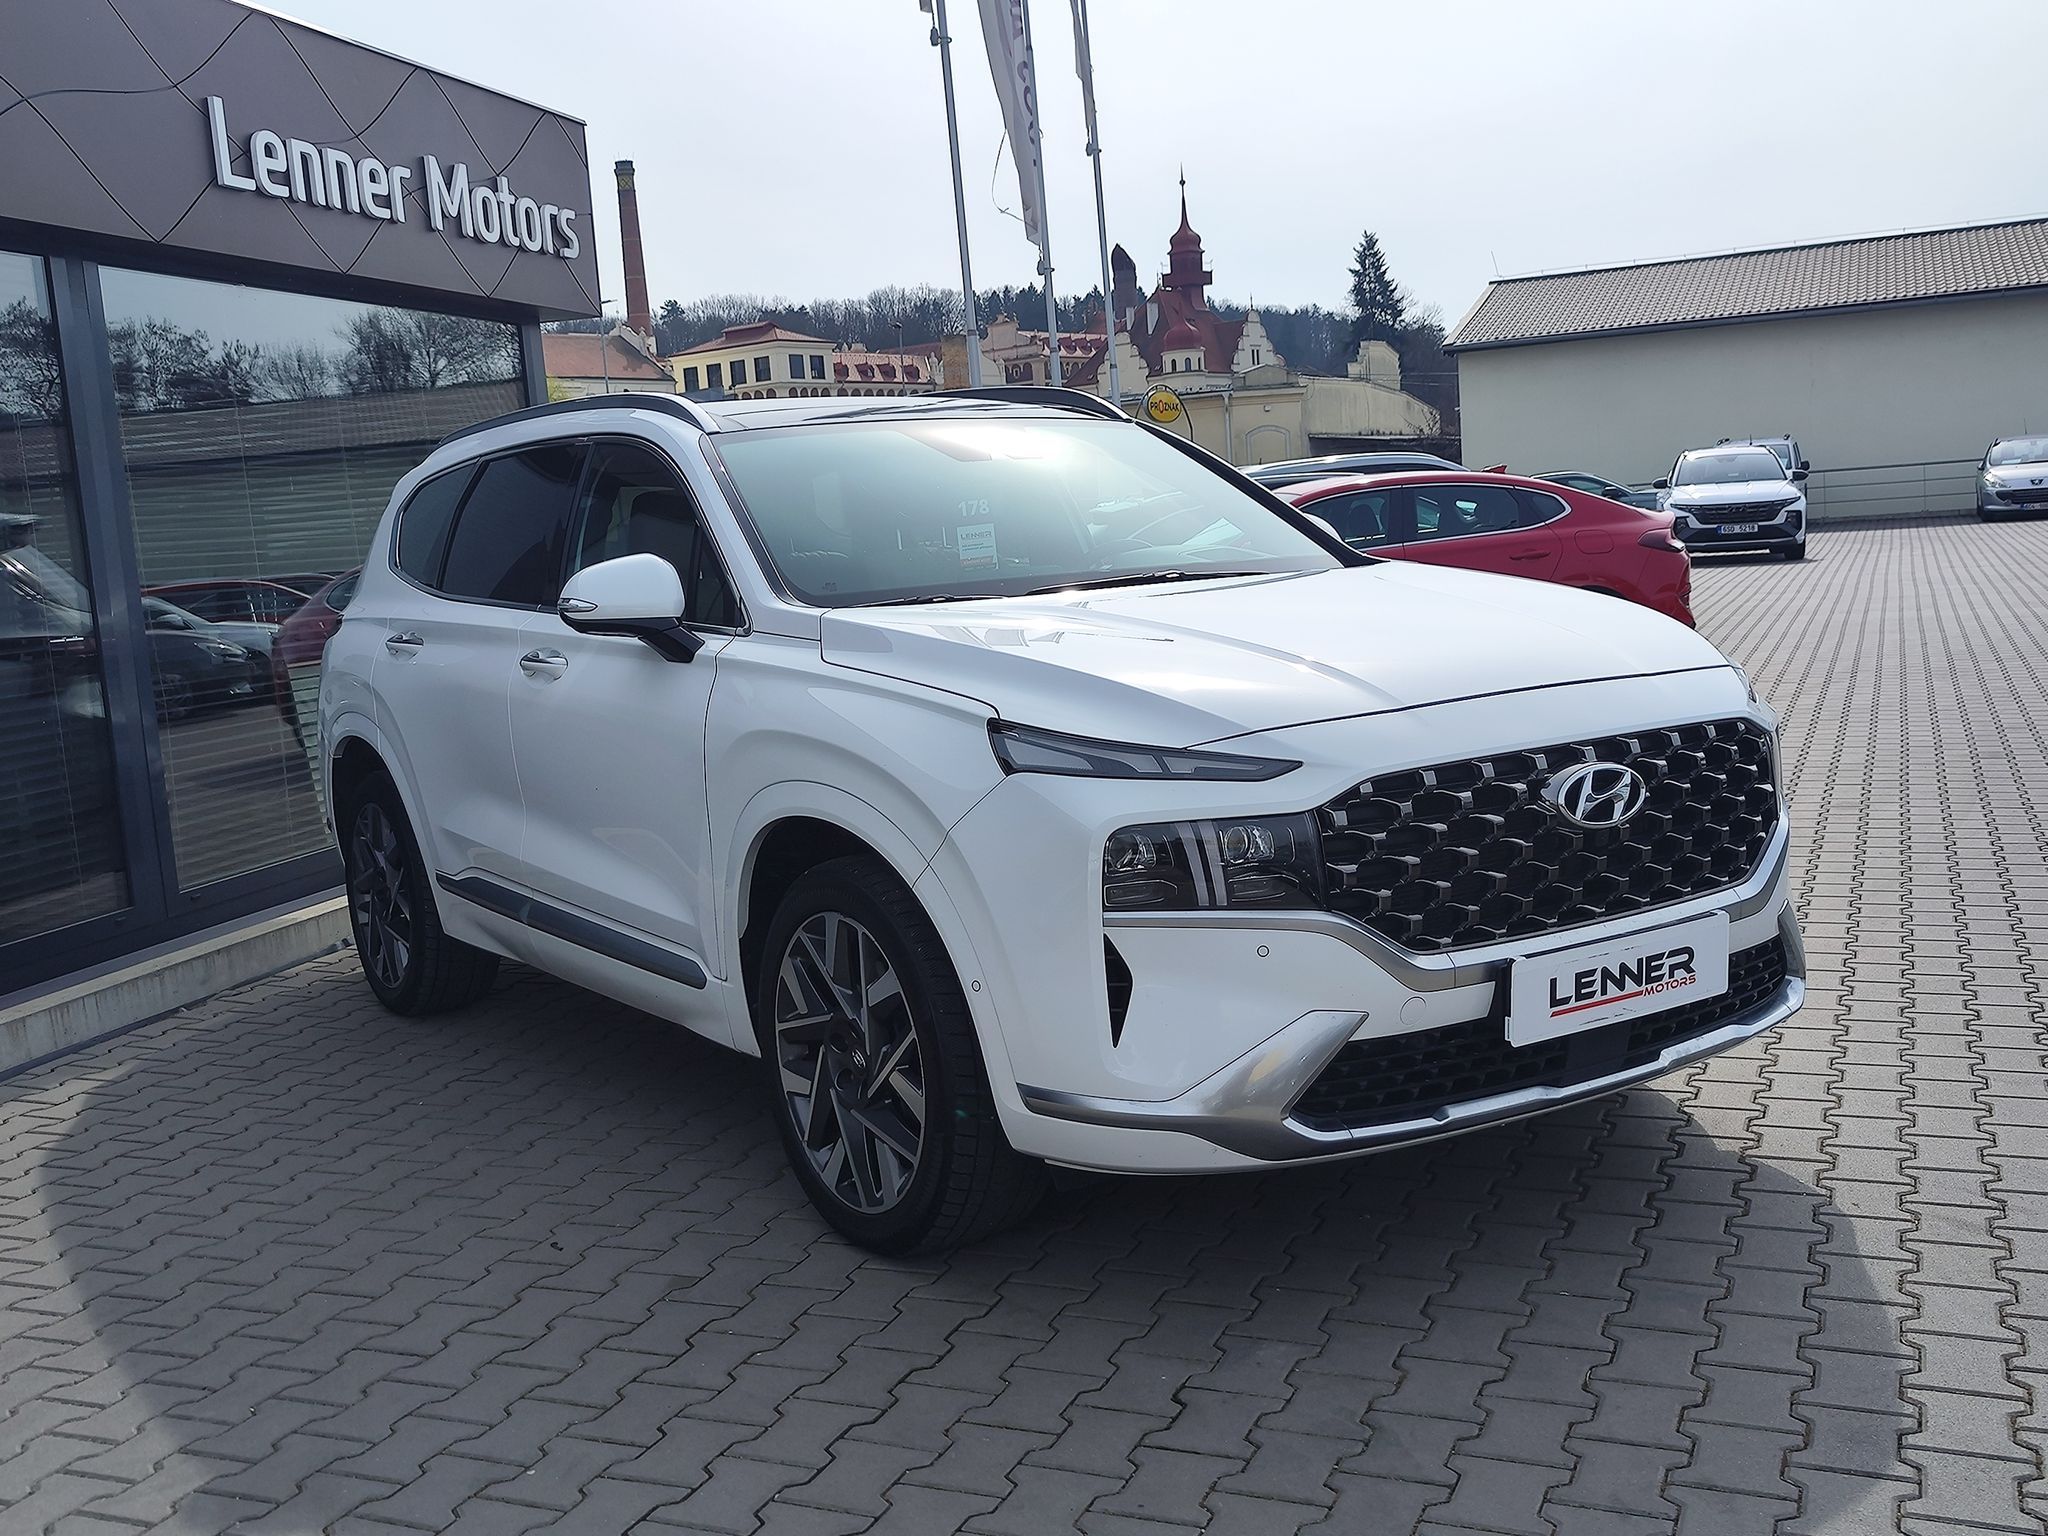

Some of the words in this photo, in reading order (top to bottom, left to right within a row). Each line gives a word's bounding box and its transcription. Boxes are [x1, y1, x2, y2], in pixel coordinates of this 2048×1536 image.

[206, 95, 412, 224] Lenner
[419, 154, 581, 259] Motors
[958, 499, 990, 517] 178
[1549, 946, 1697, 1009] LENNER
[1643, 973, 1697, 997] MOTORS
